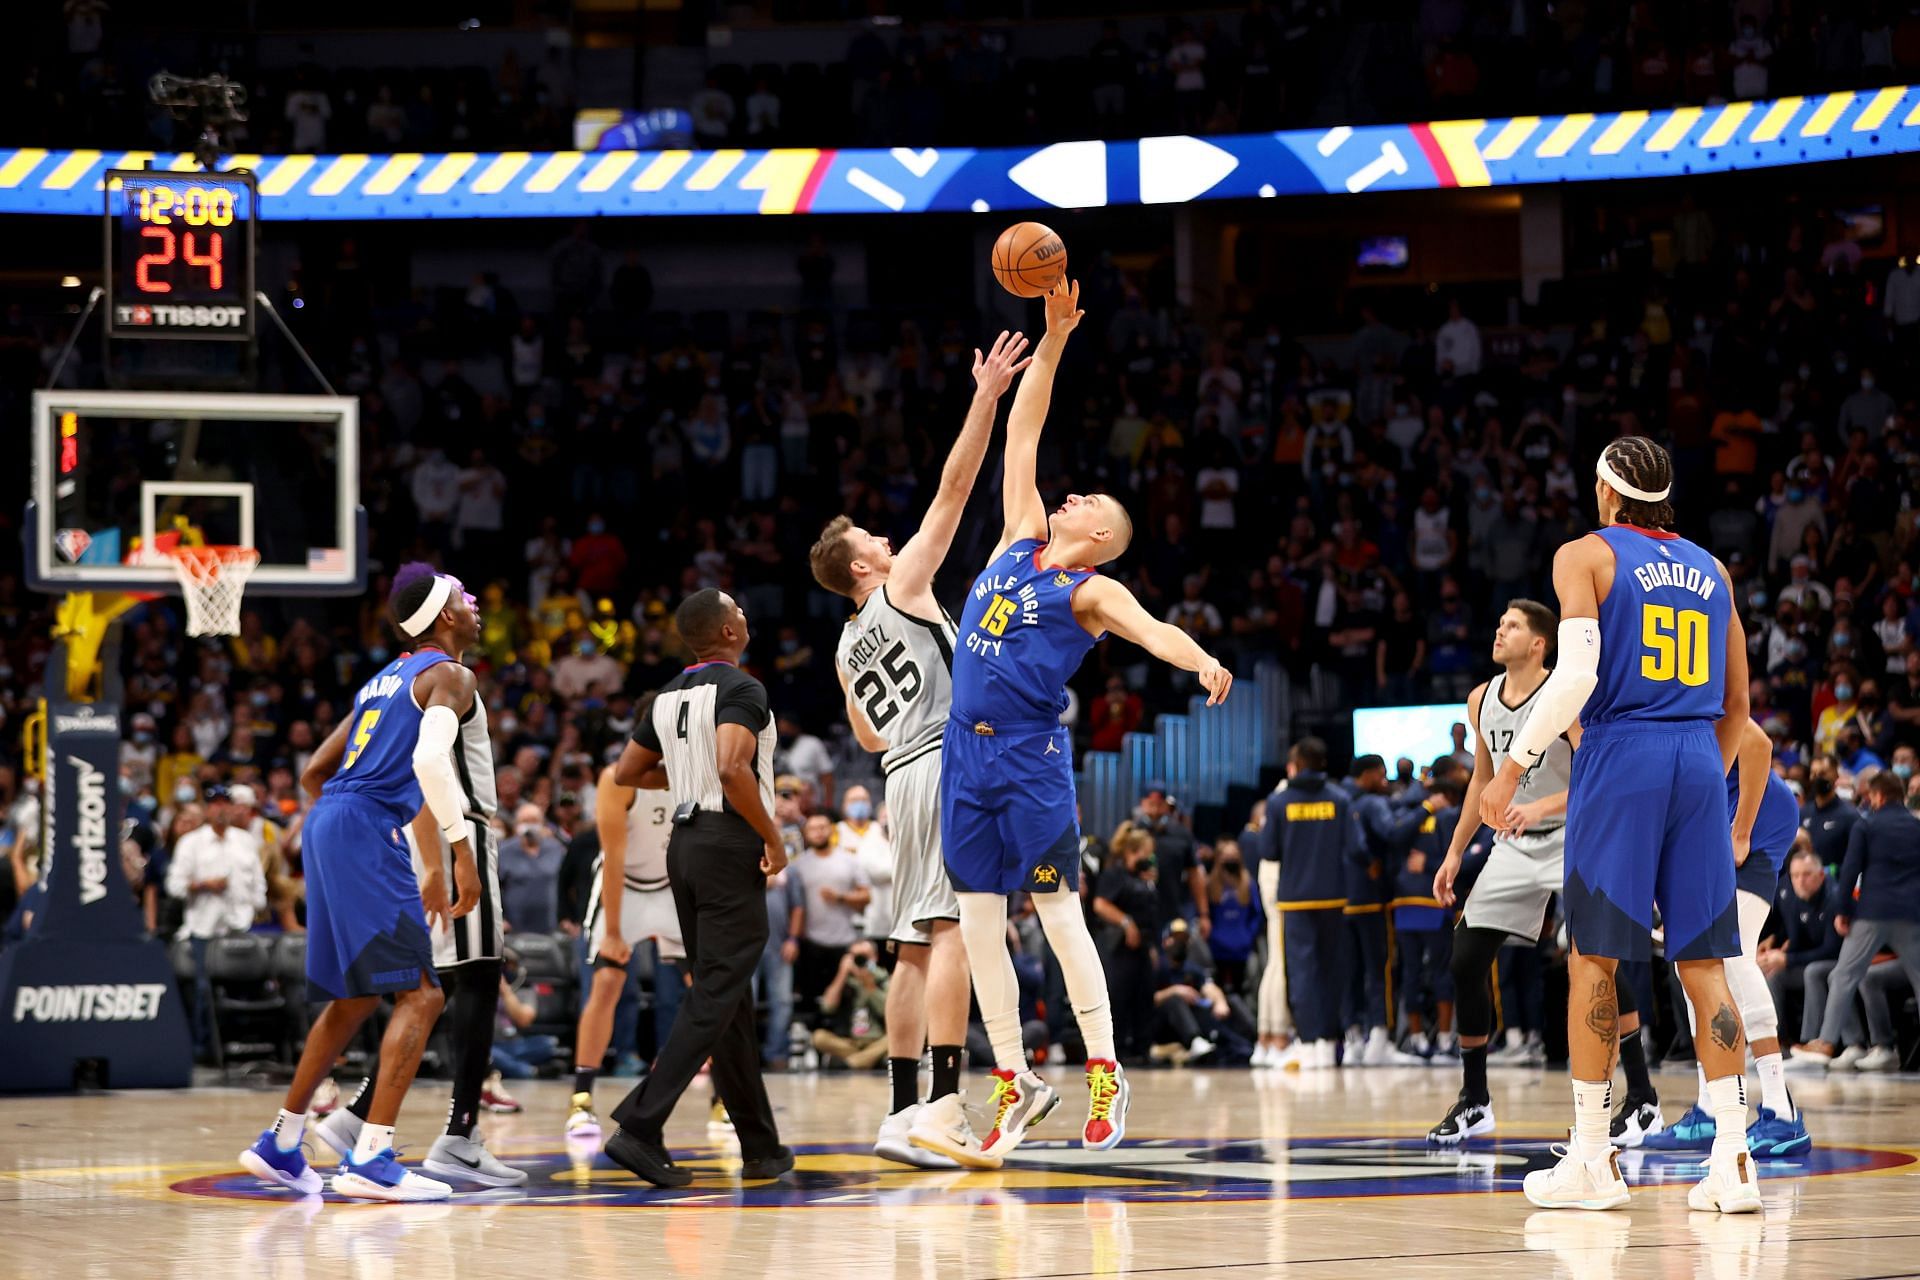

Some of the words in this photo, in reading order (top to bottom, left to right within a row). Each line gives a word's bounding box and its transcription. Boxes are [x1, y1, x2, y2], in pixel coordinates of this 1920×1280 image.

[138, 186, 233, 226] 12:00
[136, 226, 223, 293] 24
[152, 305, 246, 327] TISSOT
[975, 575, 1018, 601] MILE
[1018, 583, 1039, 625] HIGH
[1634, 562, 1716, 601] GORDON
[979, 593, 1018, 637] 15
[848, 624, 890, 672] POELTL
[966, 631, 1002, 657] CITY
[1641, 603, 1710, 687] 50
[855, 640, 921, 732] 25
[343, 709, 381, 770] 5
[676, 701, 690, 744] 4
[1490, 730, 1514, 753] 17
[71, 769, 108, 905] verizon
[652, 807, 666, 825] 3
[13, 983, 167, 1023] POINTSBET
